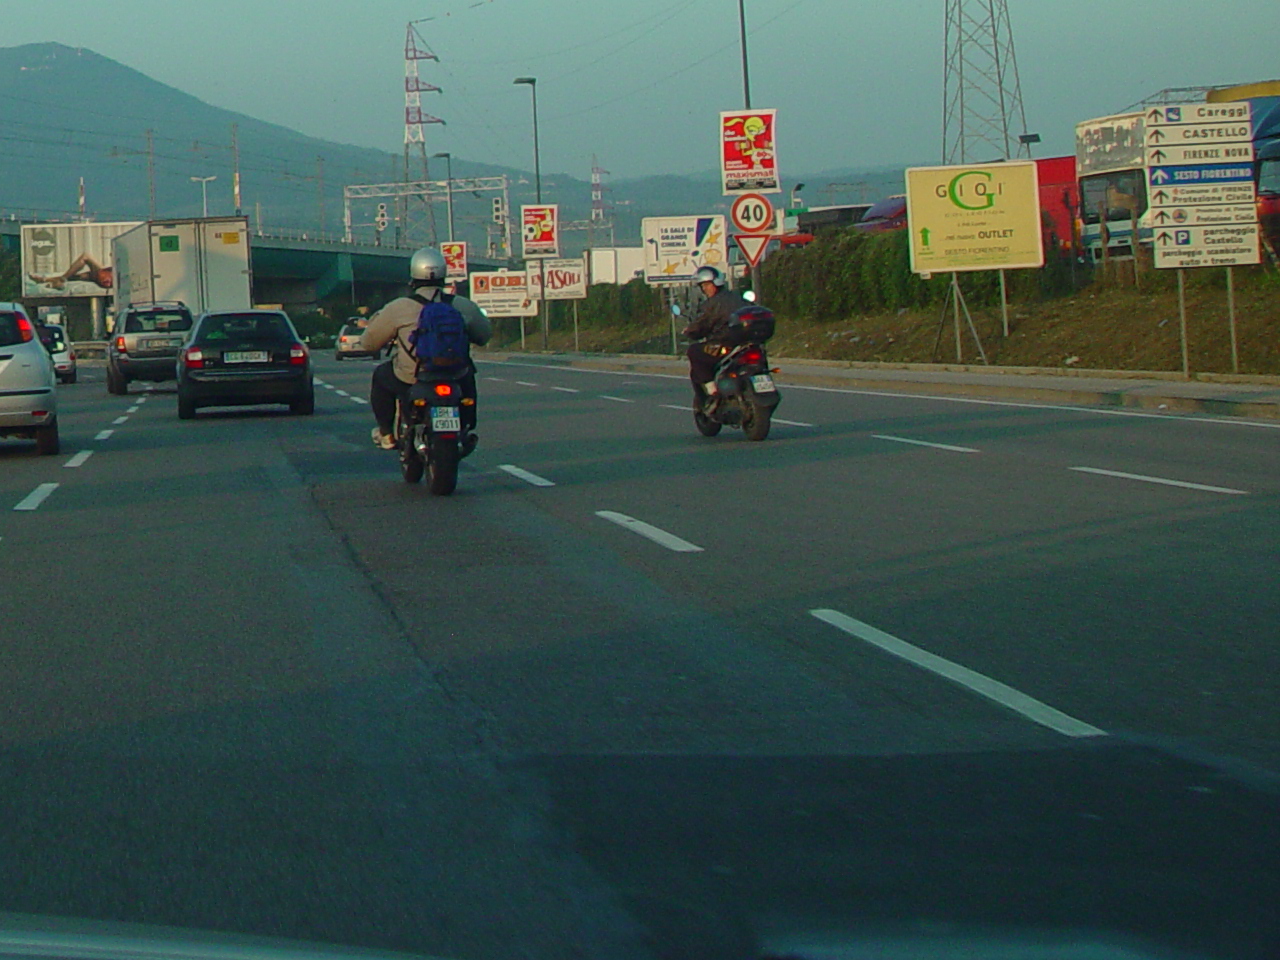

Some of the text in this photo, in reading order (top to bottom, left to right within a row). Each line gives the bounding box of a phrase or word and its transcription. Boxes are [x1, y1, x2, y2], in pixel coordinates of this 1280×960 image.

[1197, 105, 1248, 118] Careggi
[1182, 126, 1248, 139] CASTELLO
[1183, 148, 1250, 159] FIRENZE NOVA
[1174, 168, 1252, 180] SESTO FIORENTINO
[1172, 193, 1253, 203] Protezione Civile
[740, 204, 764, 223] 40
[978, 229, 1014, 239] OUTLET
[1203, 226, 1256, 236] parcheggio
[1204, 236, 1244, 244] Castello
